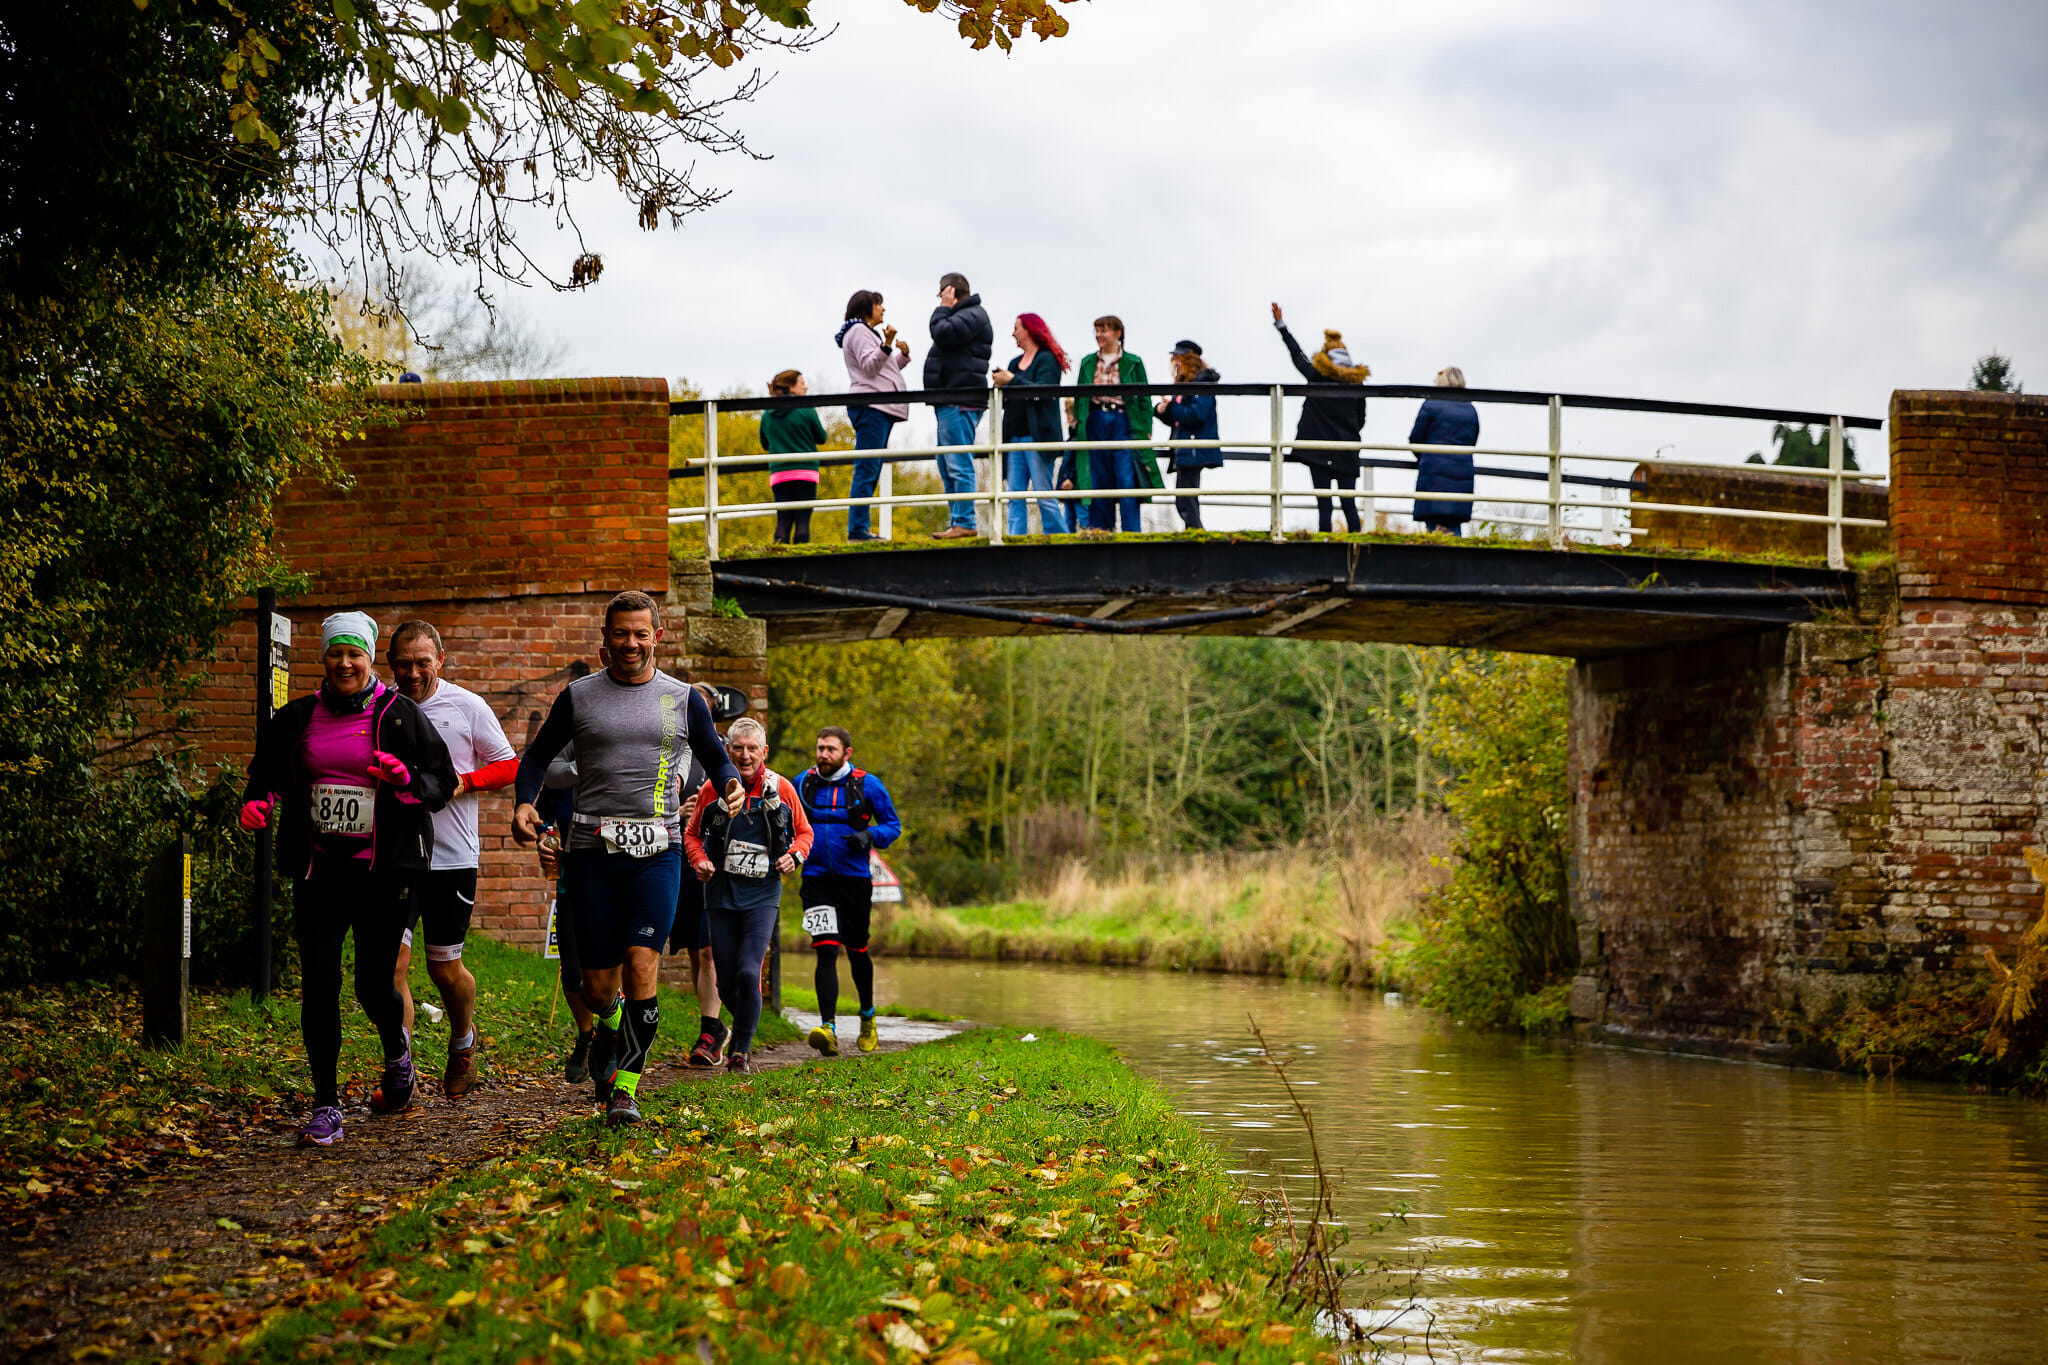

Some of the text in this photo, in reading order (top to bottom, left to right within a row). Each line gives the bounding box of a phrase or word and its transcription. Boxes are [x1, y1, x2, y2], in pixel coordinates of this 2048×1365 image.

[334, 789, 363, 797] RUNNING
[320, 797, 359, 821] 840
[615, 824, 655, 846] 830
[738, 851, 757, 869] 74
[807, 913, 829, 930] 524
